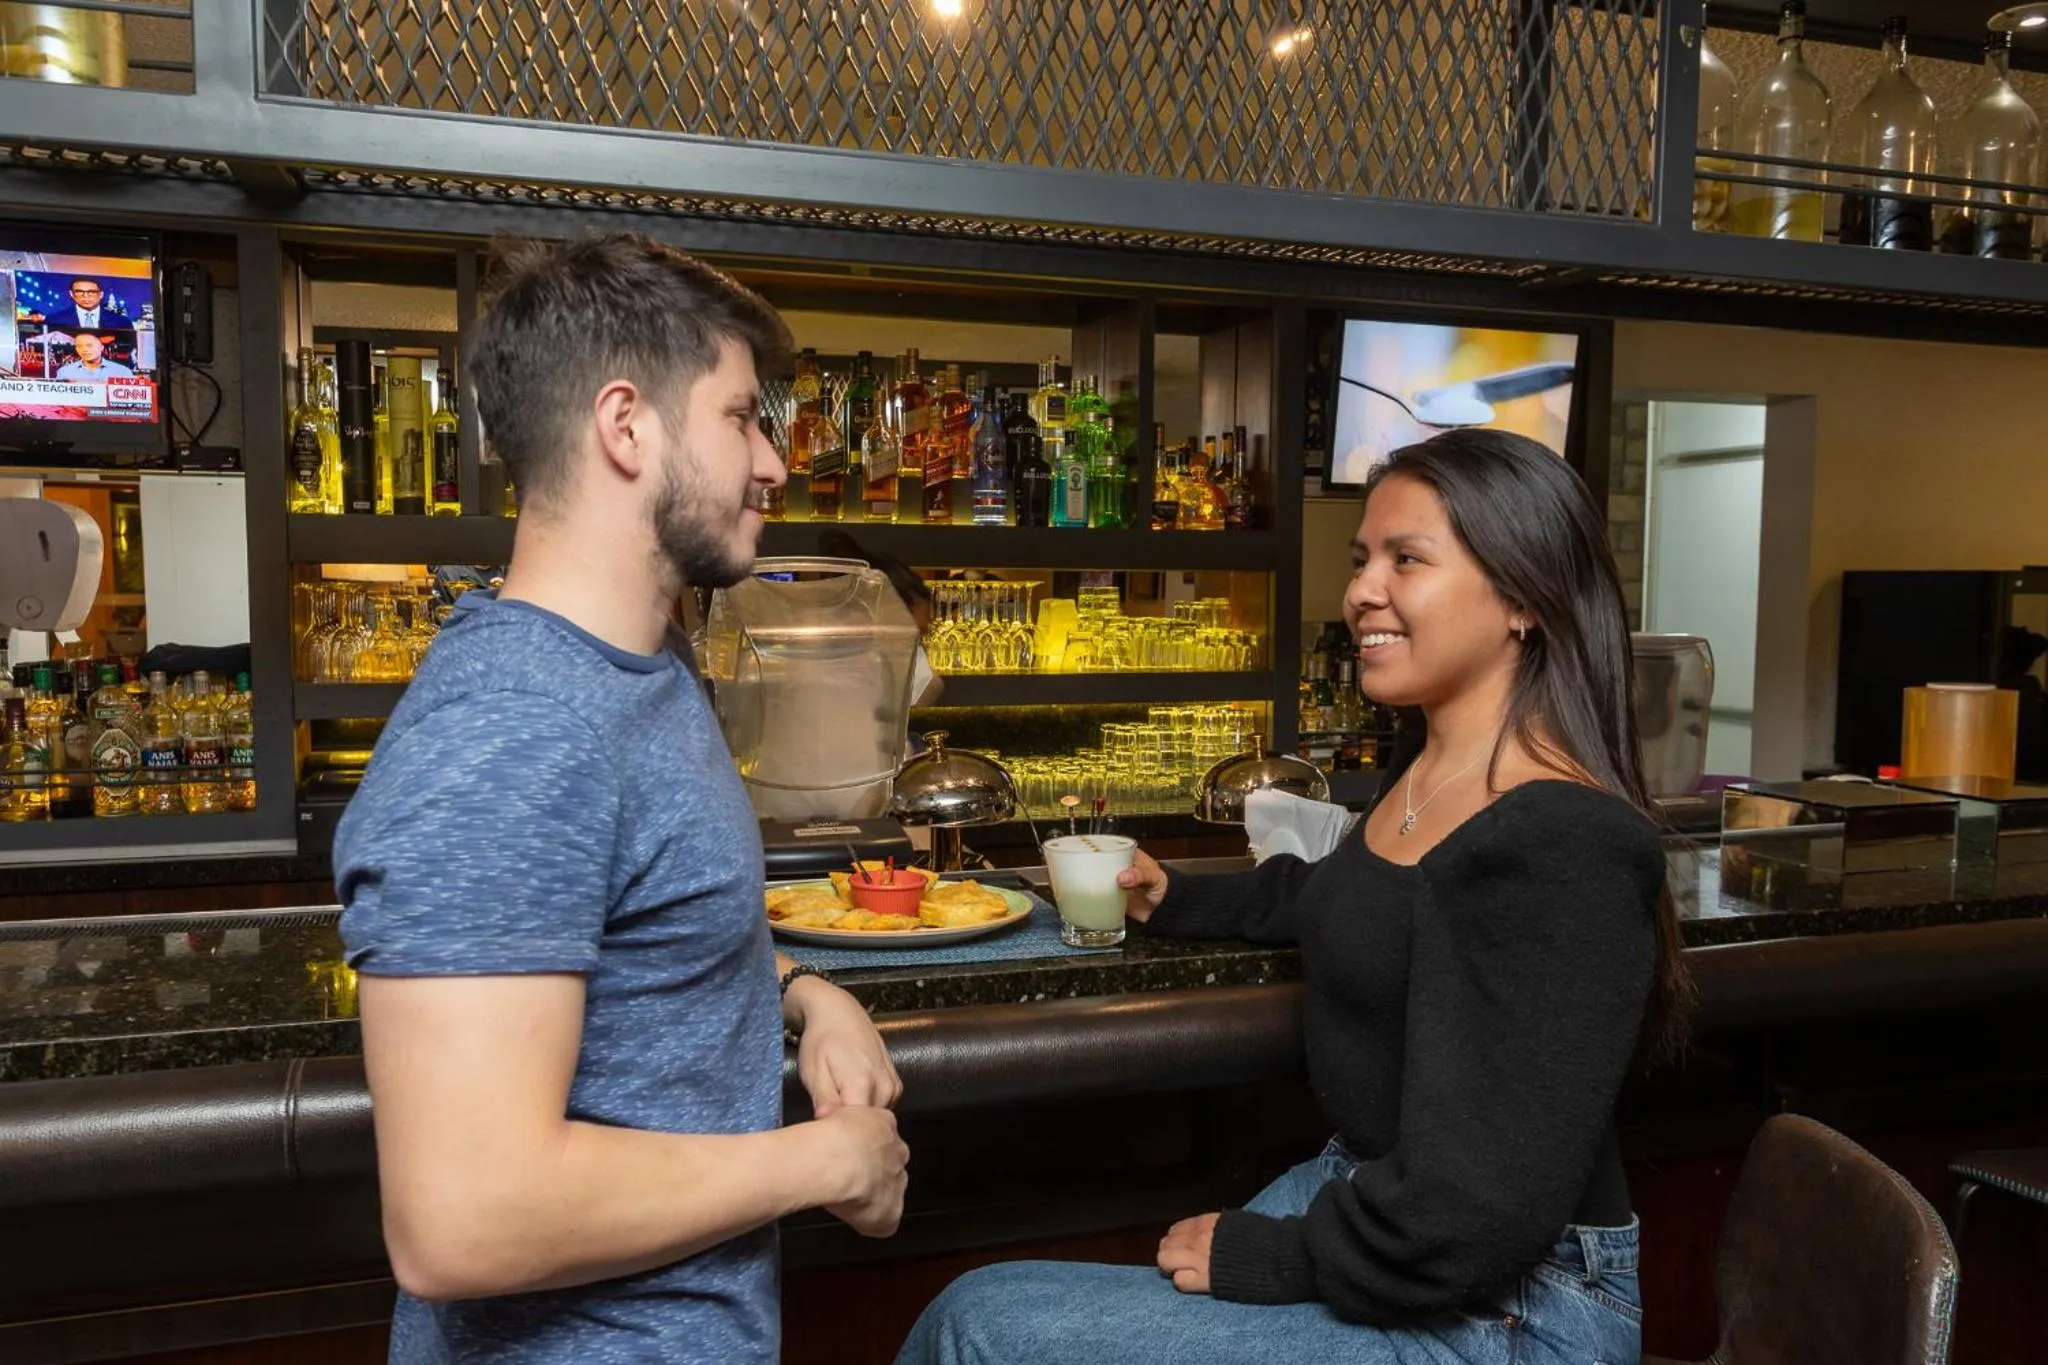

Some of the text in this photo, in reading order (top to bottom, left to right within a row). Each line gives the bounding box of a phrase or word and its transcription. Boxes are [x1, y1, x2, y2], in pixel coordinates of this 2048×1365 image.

[0, 382, 94, 394] AND 2 TEACHERS
[112, 388, 147, 400] CNN
[152, 751, 175, 760] ANIS
[193, 751, 216, 760] ANIS
